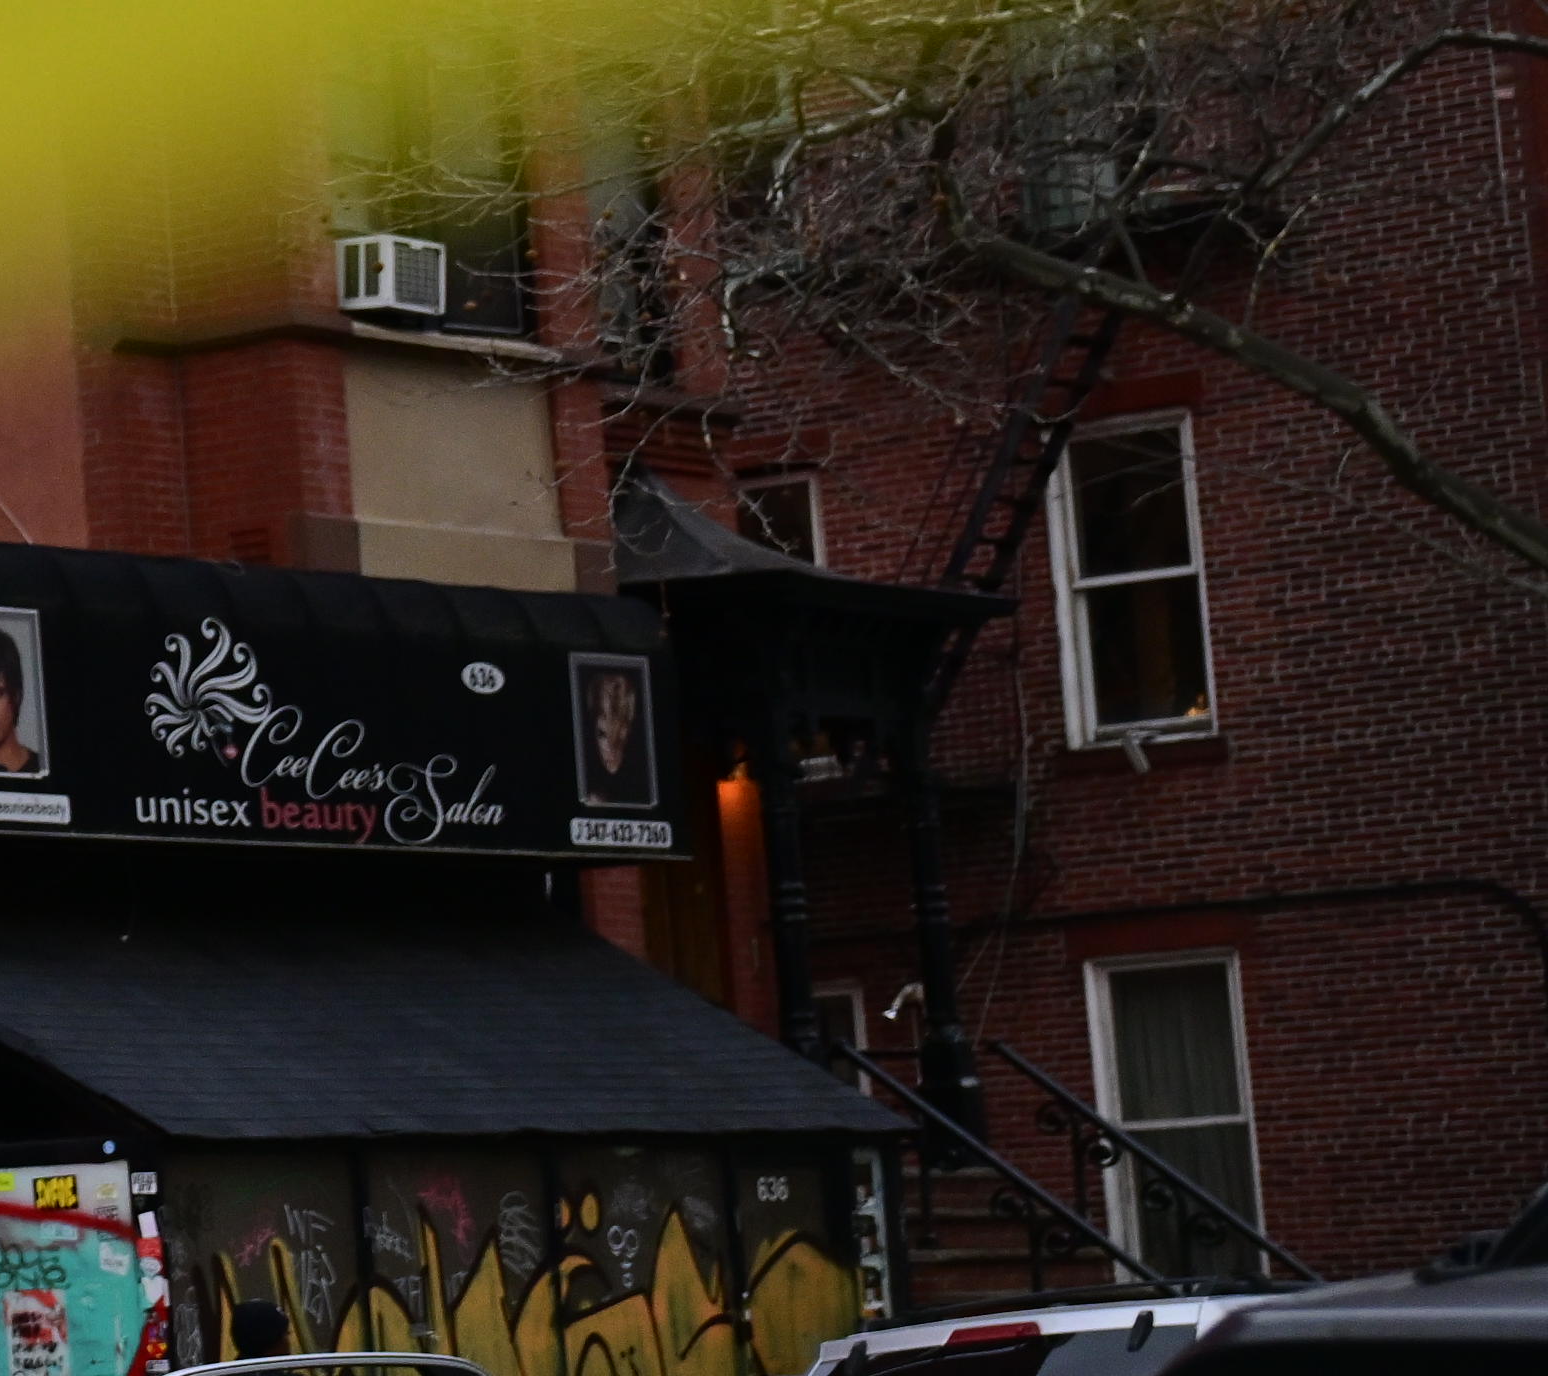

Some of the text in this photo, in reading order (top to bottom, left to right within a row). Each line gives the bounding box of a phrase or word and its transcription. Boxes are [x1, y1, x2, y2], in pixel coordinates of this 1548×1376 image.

[469, 666, 497, 690] 636
[134, 785, 378, 845] unisex beauty
[383, 753, 506, 845] Salon
[756, 1176, 790, 1202] 636
